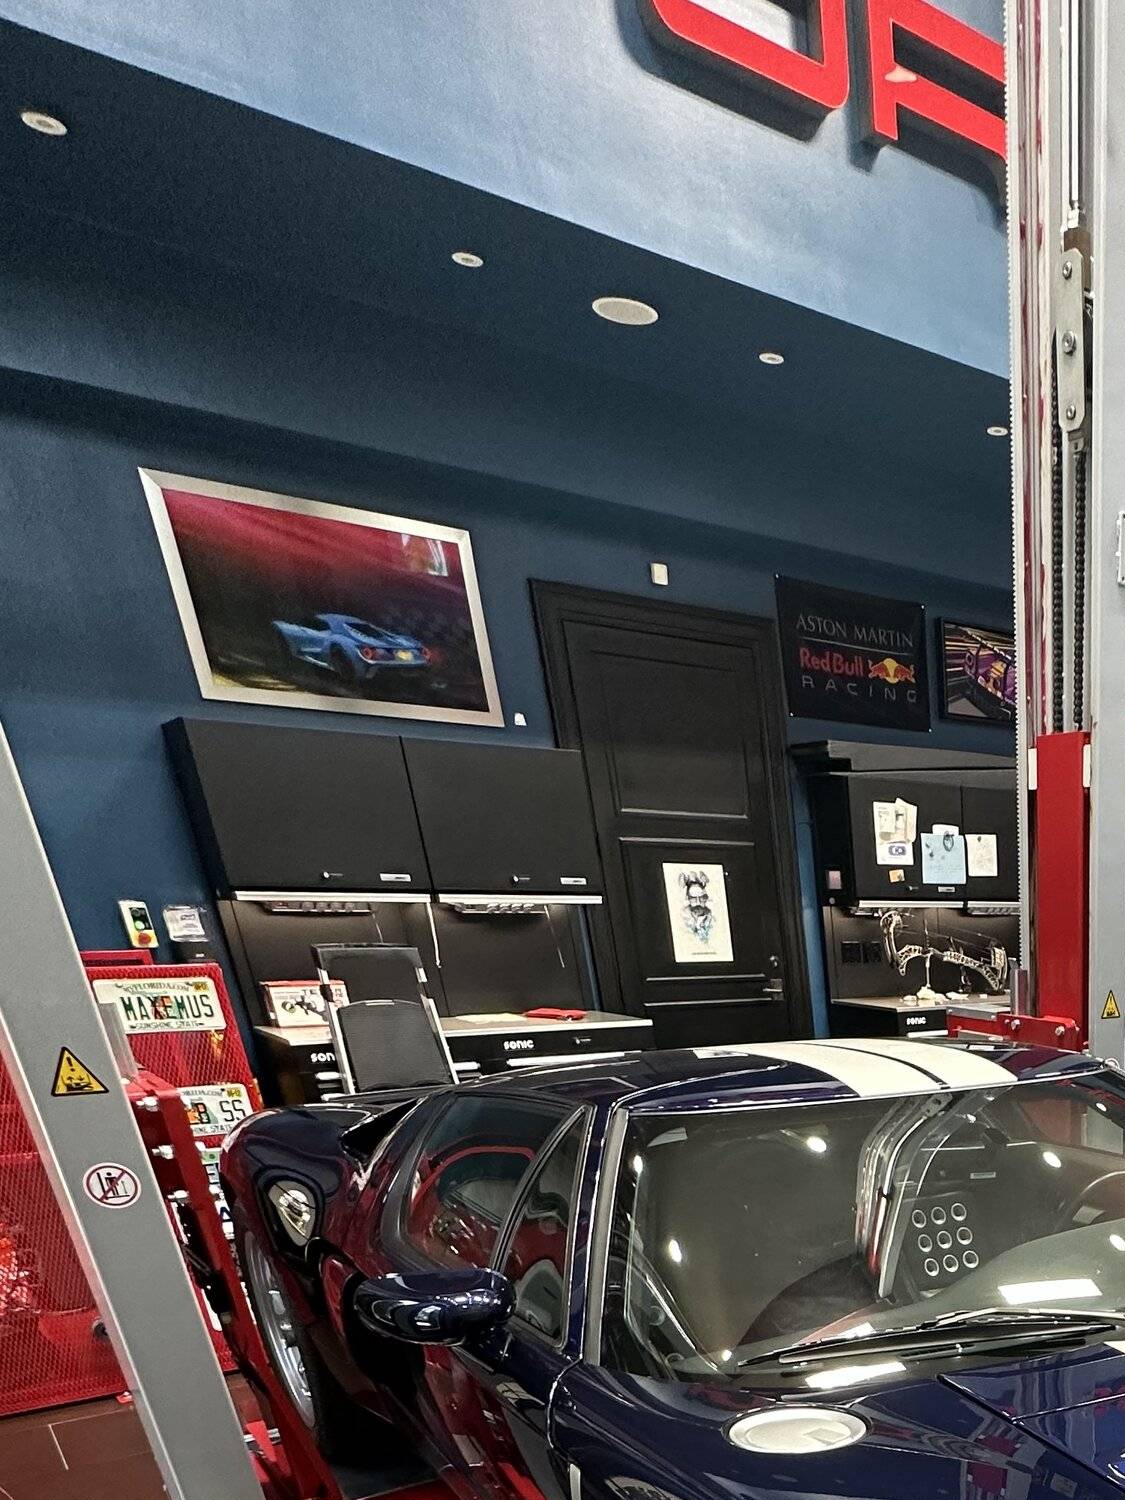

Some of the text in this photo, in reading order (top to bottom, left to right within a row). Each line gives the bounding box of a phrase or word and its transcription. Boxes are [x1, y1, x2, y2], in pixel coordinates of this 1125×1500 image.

[797, 614, 913, 647] ASTON MARTIN
[800, 647, 863, 677] Red Bull
[802, 675, 917, 702] RACING
[120, 994, 214, 1021] MAXEMUS
[135, 1020, 199, 1030] SUNSHINE STATE
[310, 1052, 335, 1063] son
[503, 1038, 534, 1051] sonic
